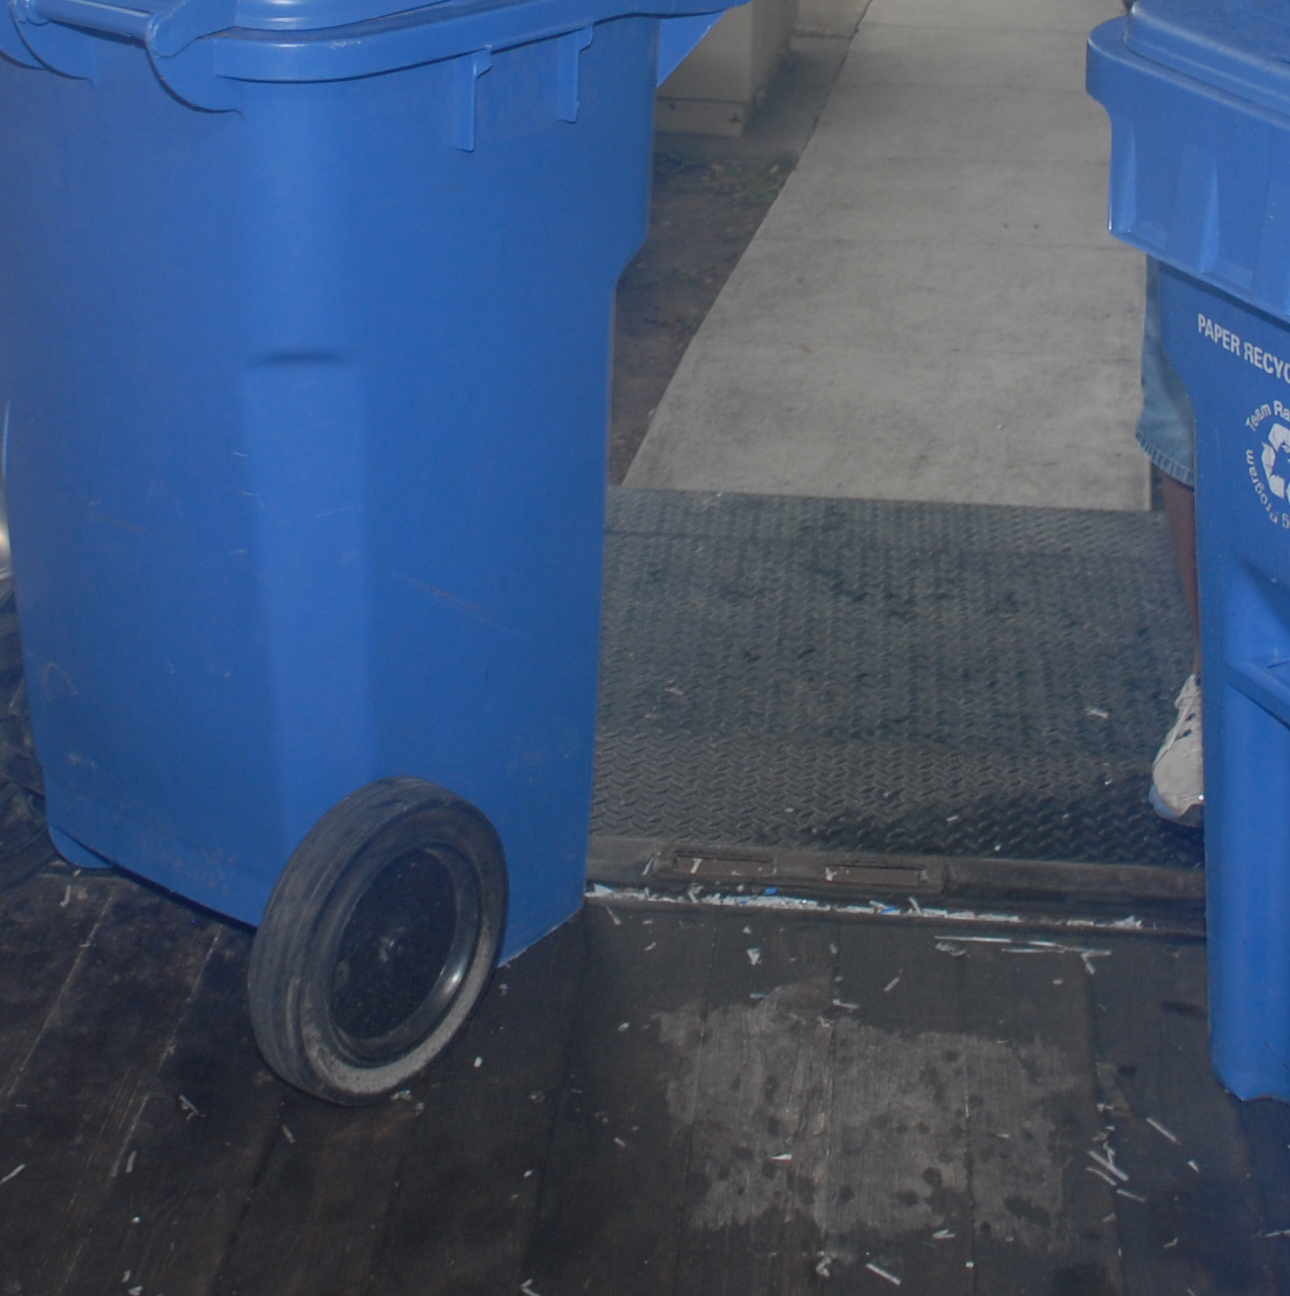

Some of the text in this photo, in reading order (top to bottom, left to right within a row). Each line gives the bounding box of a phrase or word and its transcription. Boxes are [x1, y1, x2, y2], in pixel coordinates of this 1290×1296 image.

[1197, 313, 1241, 357] PAPER
[1245, 403, 1271, 432] Team
[1245, 449, 1279, 524] Program
